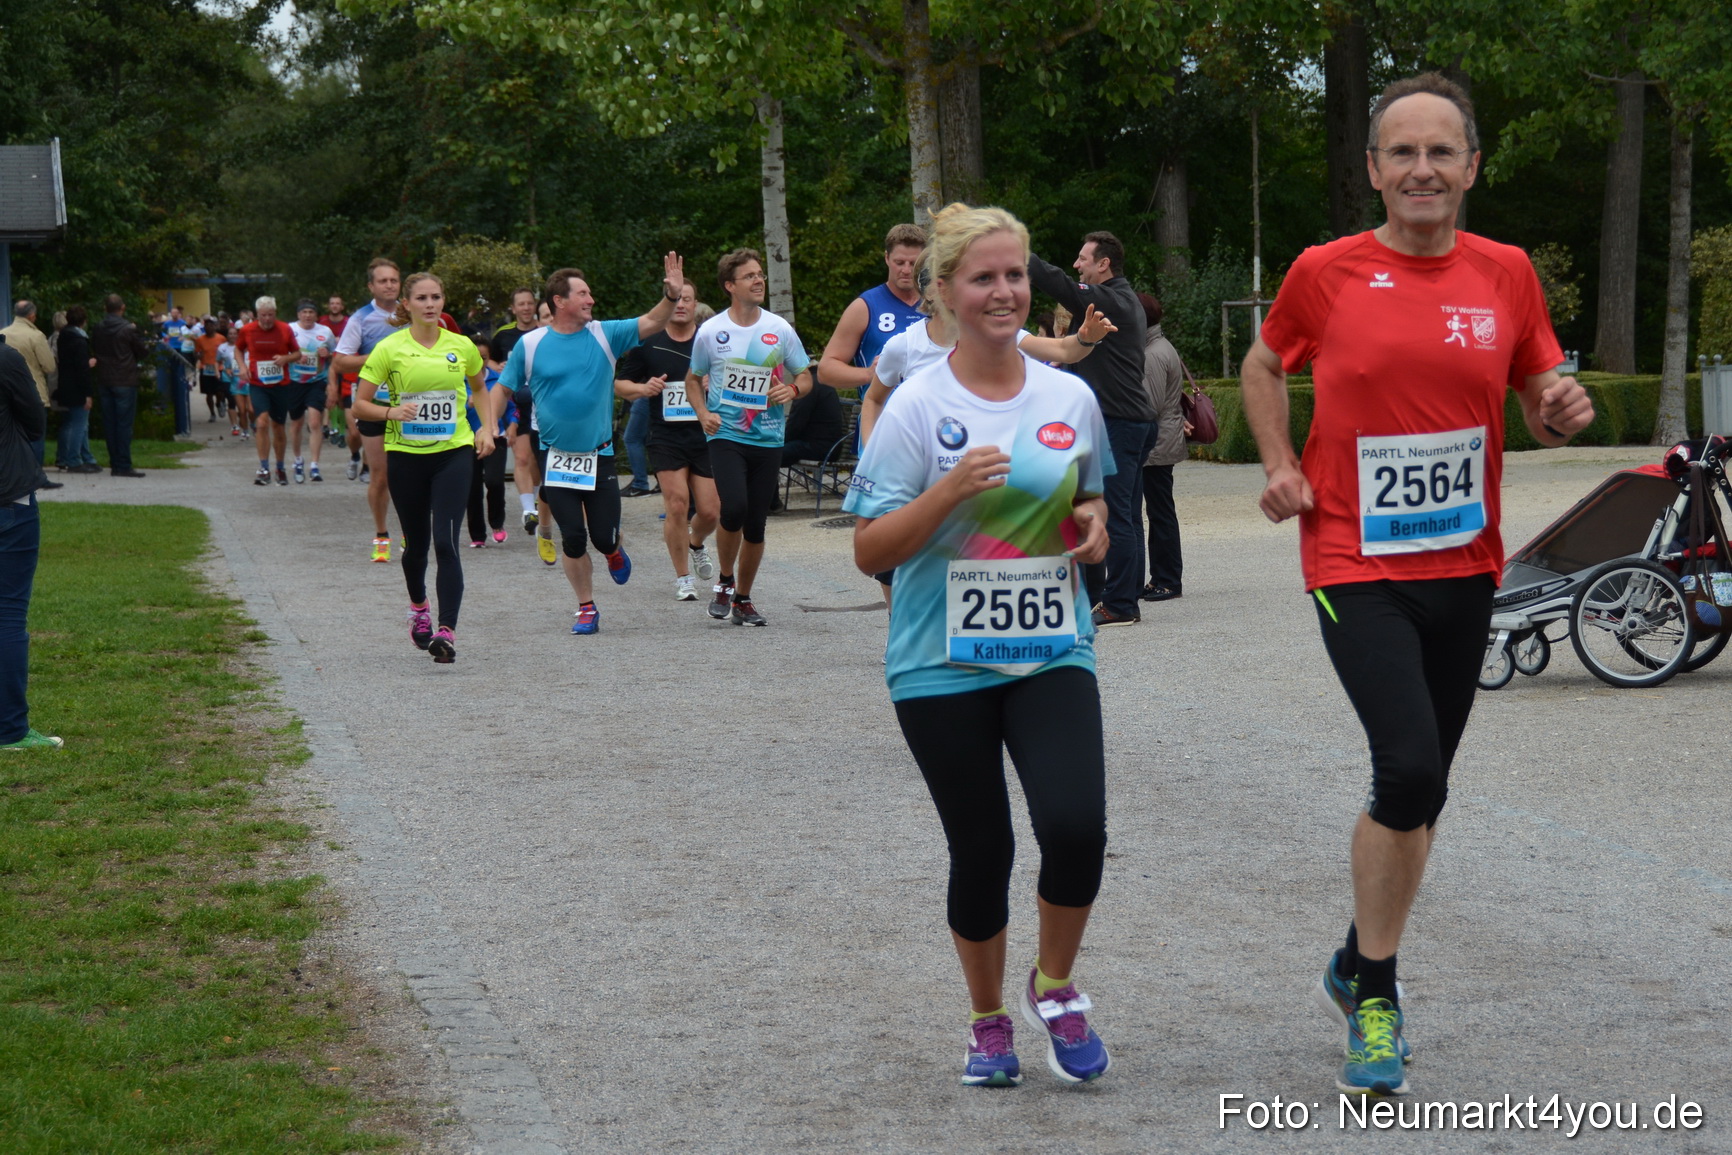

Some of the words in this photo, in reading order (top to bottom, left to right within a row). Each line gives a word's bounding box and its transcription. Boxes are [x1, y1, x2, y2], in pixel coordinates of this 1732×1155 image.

[1440, 305, 1457, 313] TSV
[878, 312, 896, 332] 8
[727, 373, 767, 393] 2417
[732, 393, 758, 404] Andreas
[413, 402, 452, 421] 499
[676, 408, 694, 416] Oliver
[412, 425, 447, 434] Franziska
[1361, 447, 1405, 460] PARTL
[1408, 443, 1465, 458] Neumarkt
[552, 455, 593, 474] 2420
[561, 473, 580, 483] Franz
[1374, 457, 1473, 508] 2564
[1366, 506, 1372, 514] A
[1390, 513, 1461, 537] Bernhard
[950, 571, 994, 582] PARTL
[997, 570, 1052, 581] Neumarkt
[961, 586, 1064, 631] 2565
[952, 627, 958, 635] D
[973, 642, 1053, 660] Katharina
